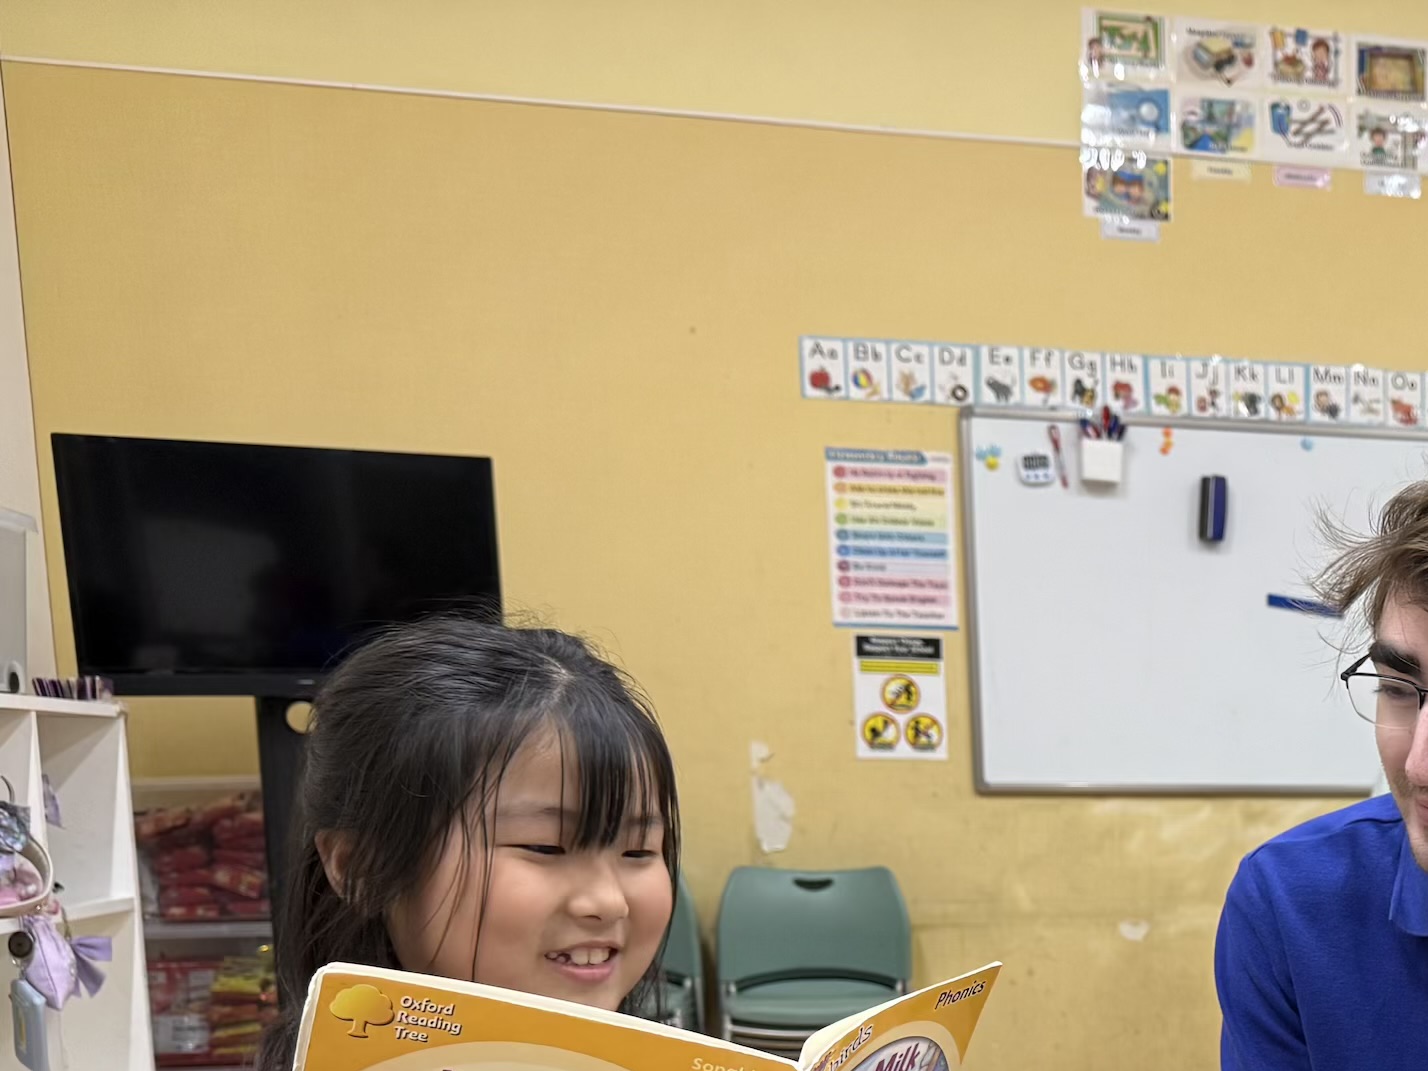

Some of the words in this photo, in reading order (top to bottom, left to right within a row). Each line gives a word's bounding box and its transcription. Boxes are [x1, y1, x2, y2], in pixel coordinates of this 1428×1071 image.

[400, 995, 456, 1016] Oxford
[934, 979, 986, 1011] Phonics
[394, 1025, 428, 1043] Tree
[396, 1010, 462, 1036] Reading
